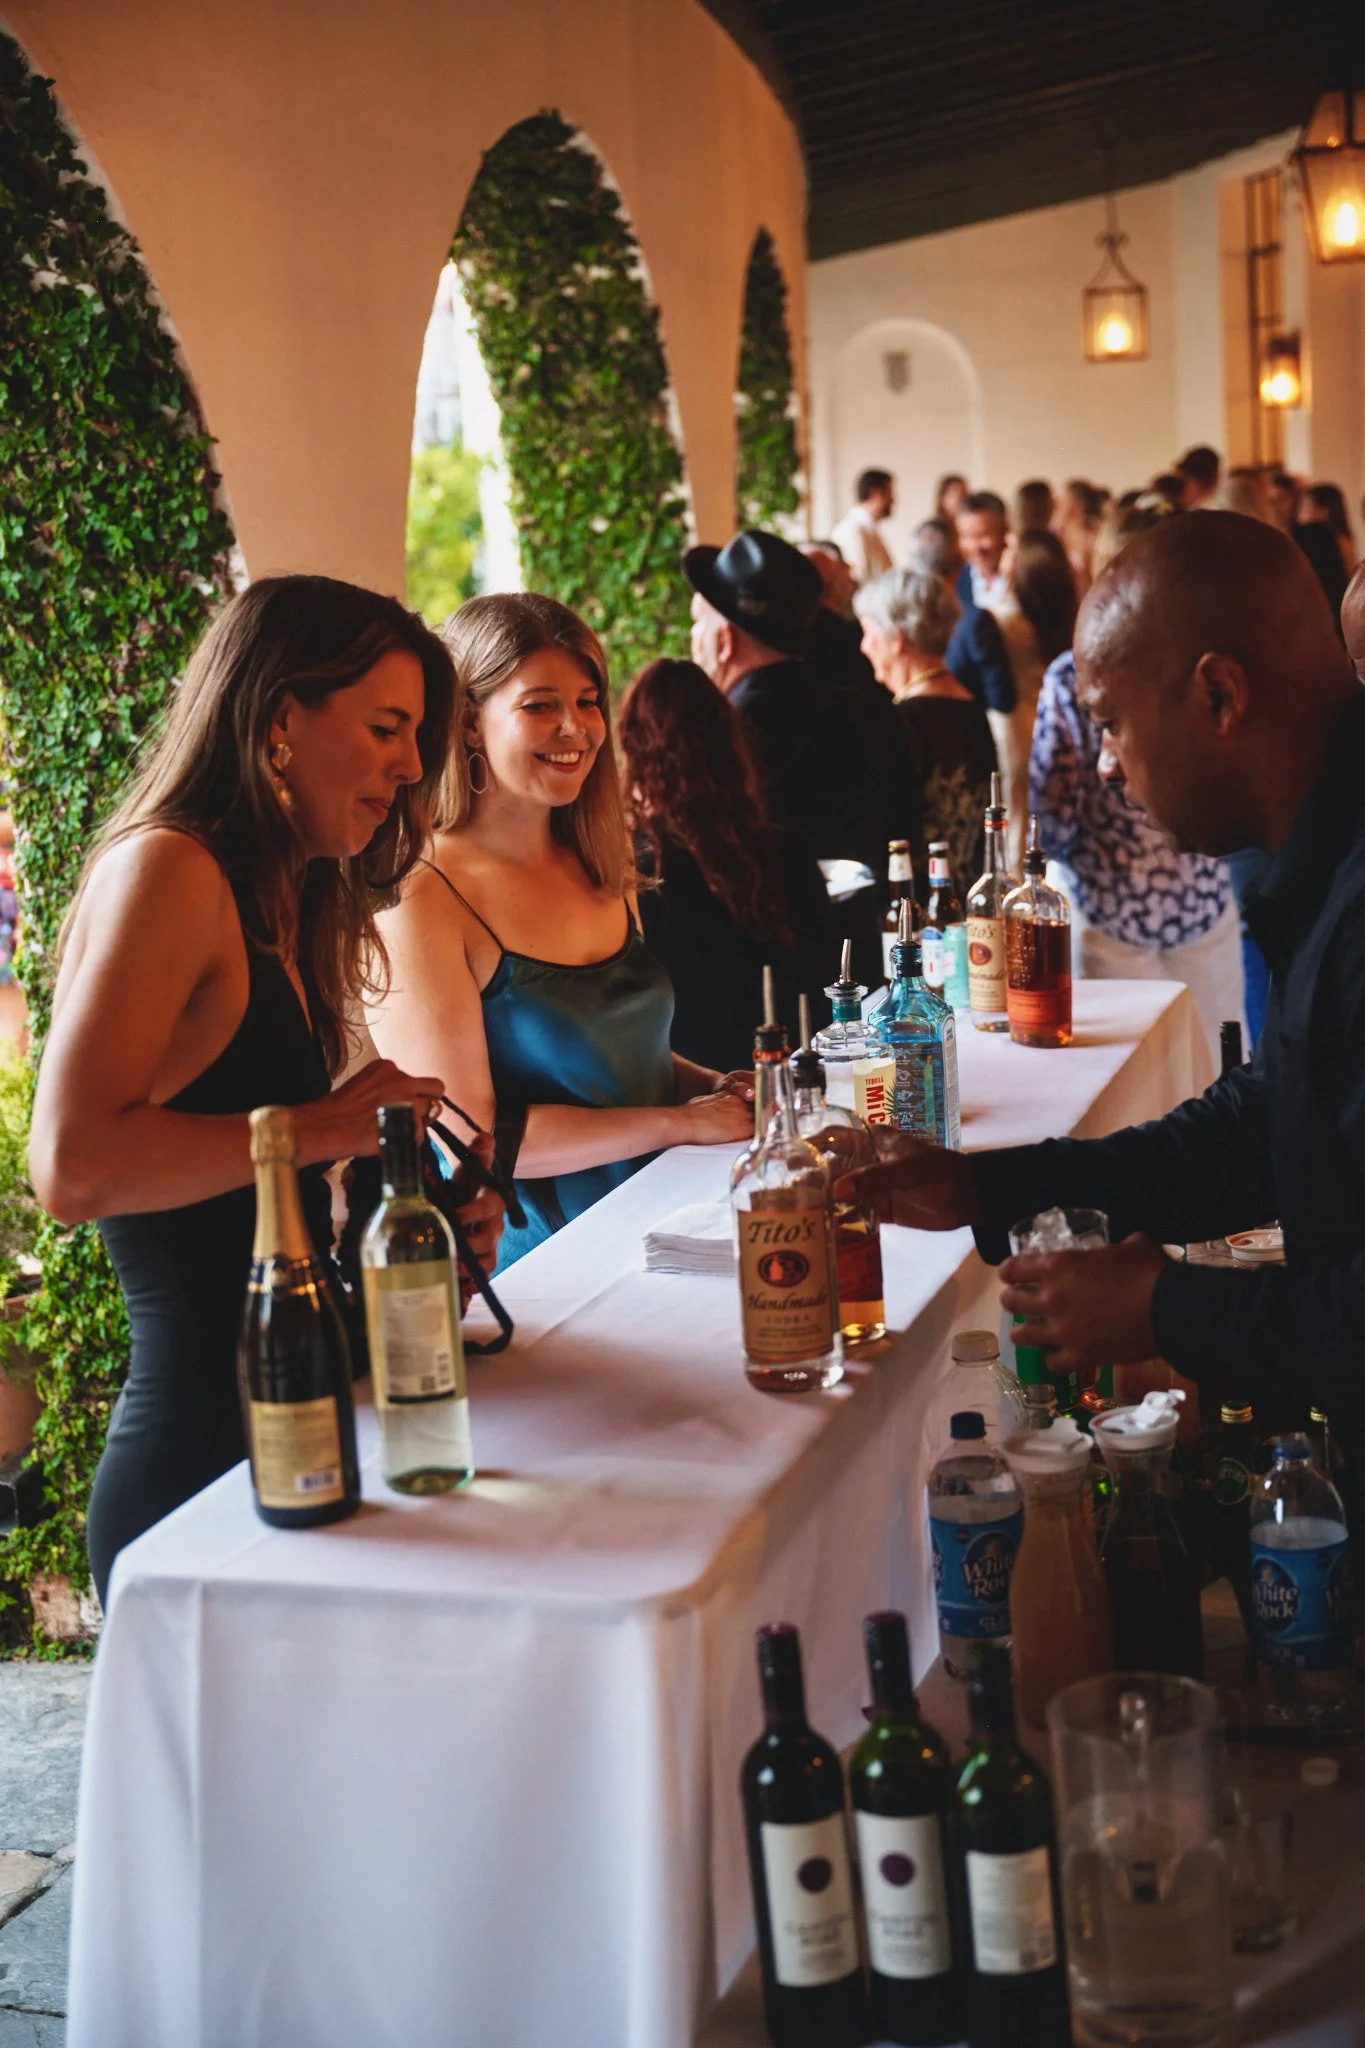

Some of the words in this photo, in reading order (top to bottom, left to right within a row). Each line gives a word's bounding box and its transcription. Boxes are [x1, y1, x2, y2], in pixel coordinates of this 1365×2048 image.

[866, 1085, 885, 1110] Mi
[868, 1112, 886, 1125] C
[747, 1218, 816, 1244] Tito's
[972, 1575, 1009, 1598] Roc
